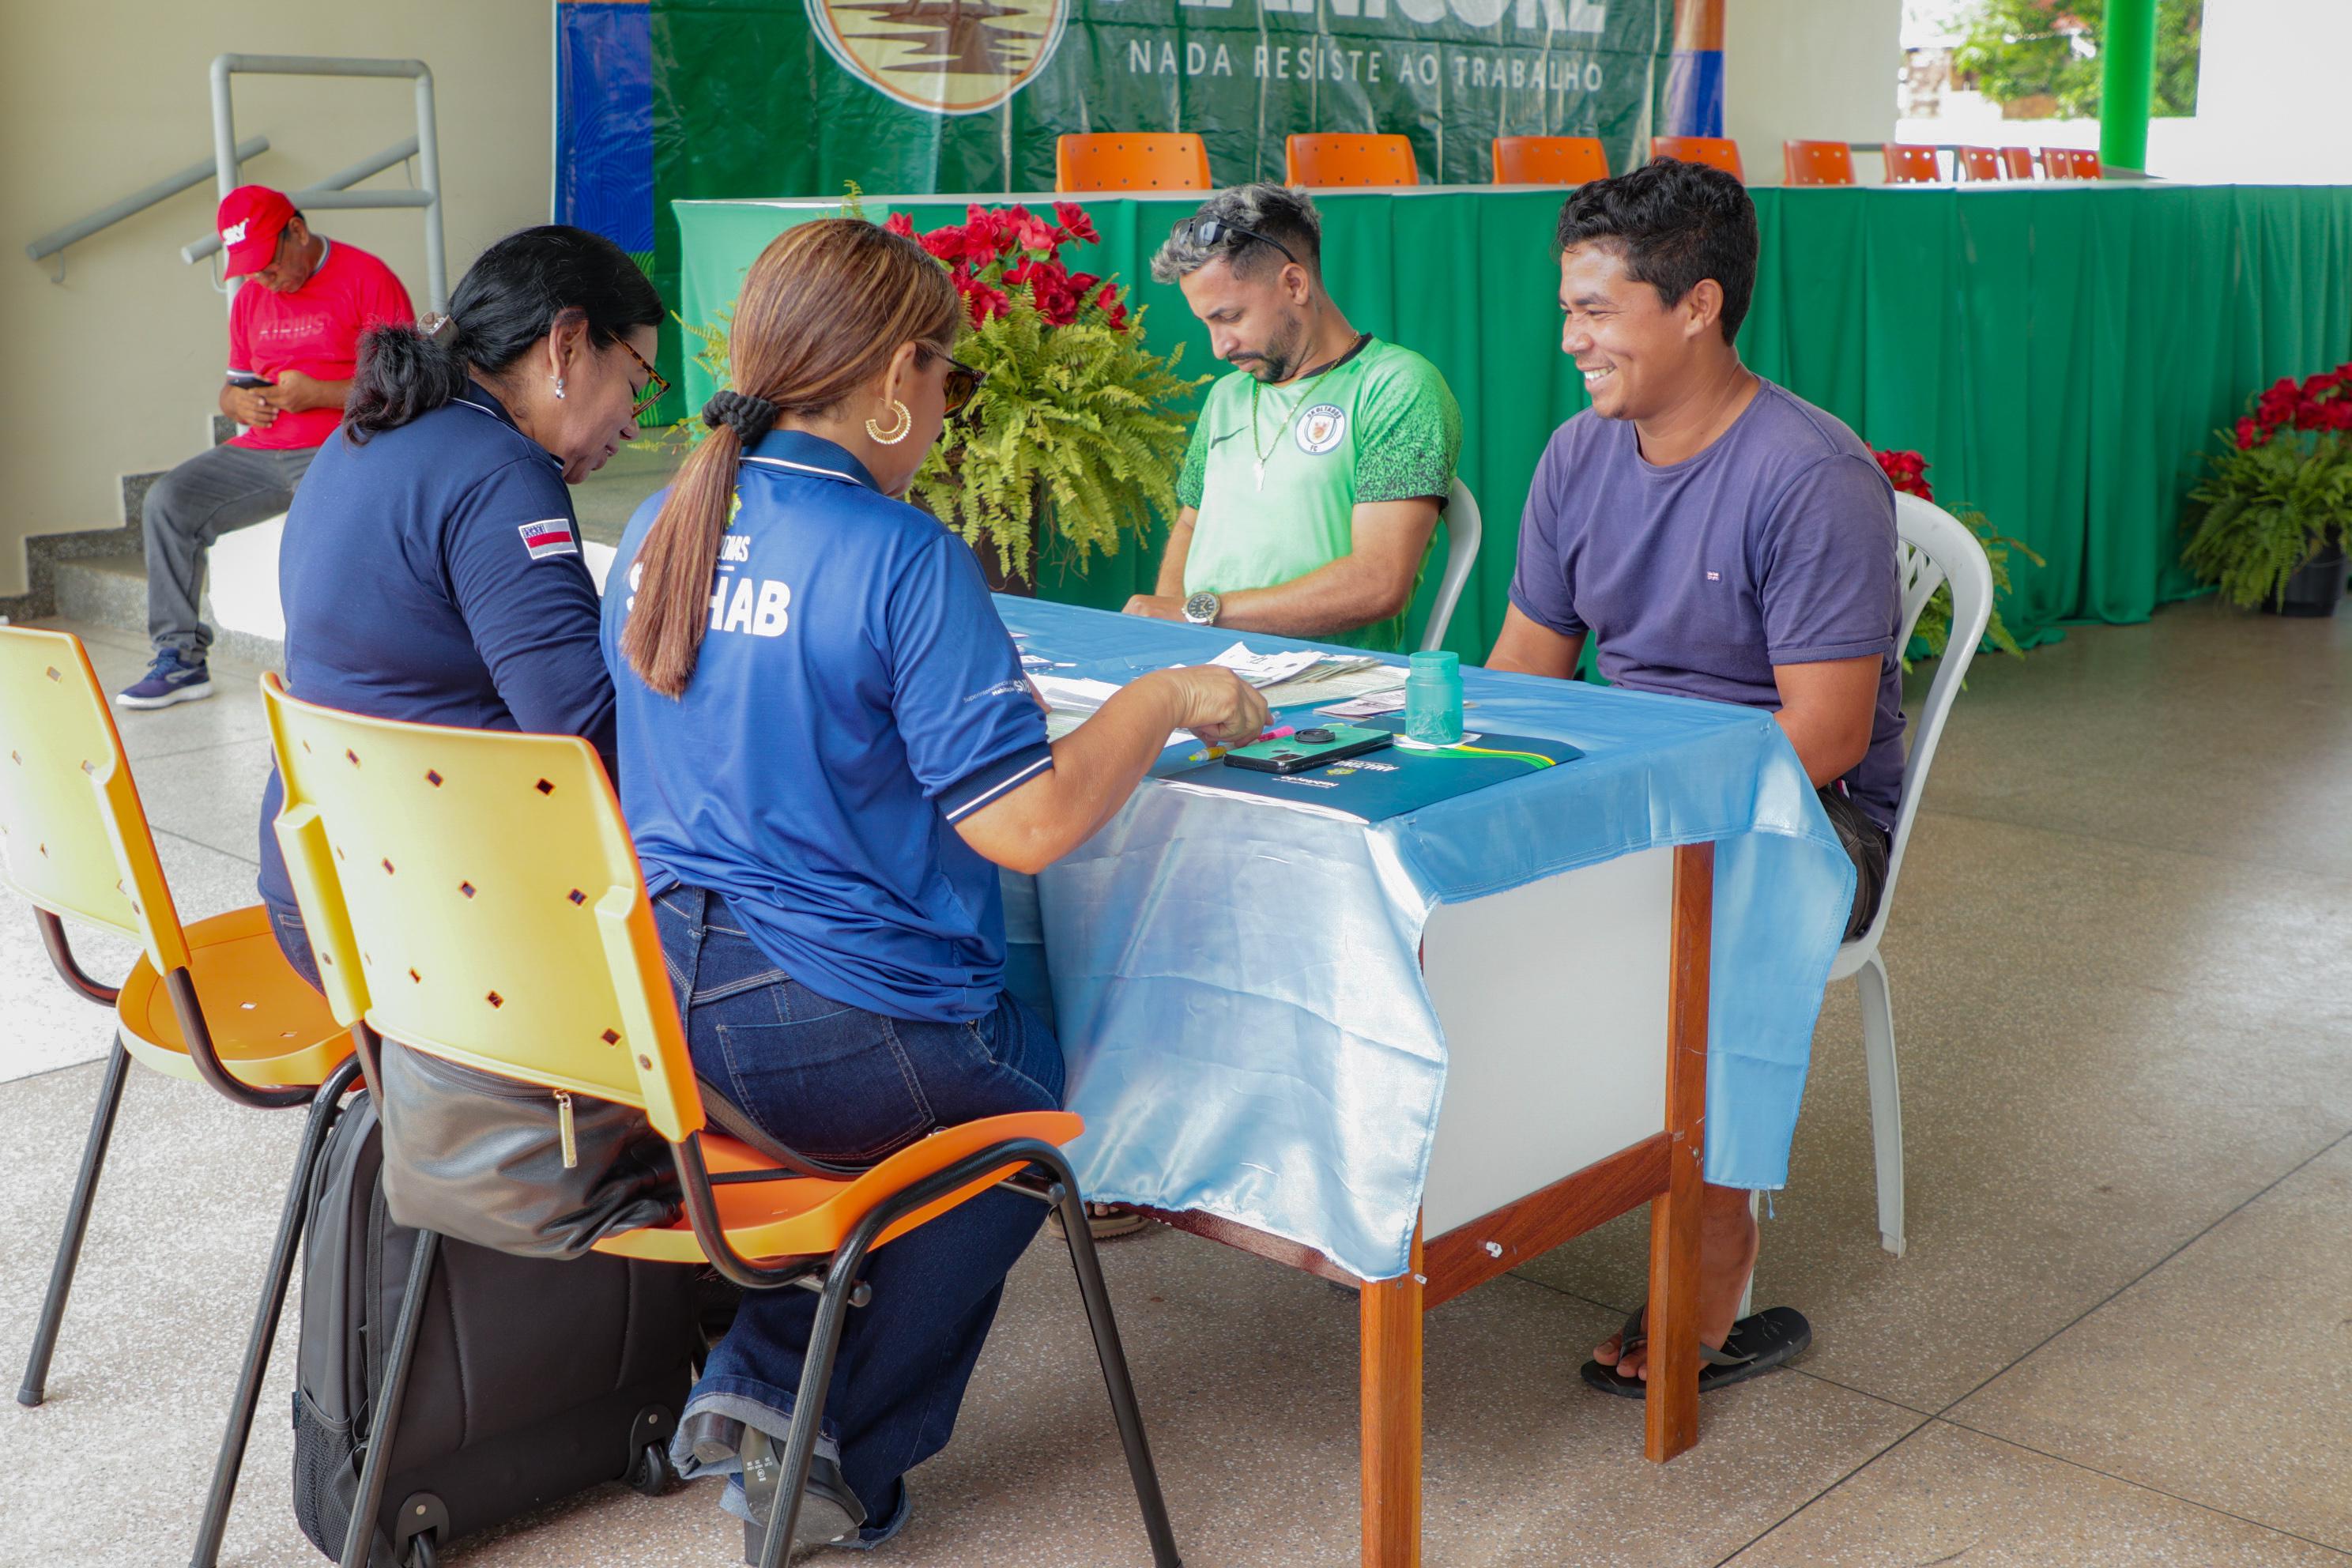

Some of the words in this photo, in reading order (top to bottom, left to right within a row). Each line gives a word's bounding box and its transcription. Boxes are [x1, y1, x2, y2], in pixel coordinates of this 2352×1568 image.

[1129, 39, 1233, 77] NADA
[1254, 45, 1382, 82] RESISTE
[1398, 54, 1438, 85] AO
[1455, 56, 1603, 92] TRABALHO
